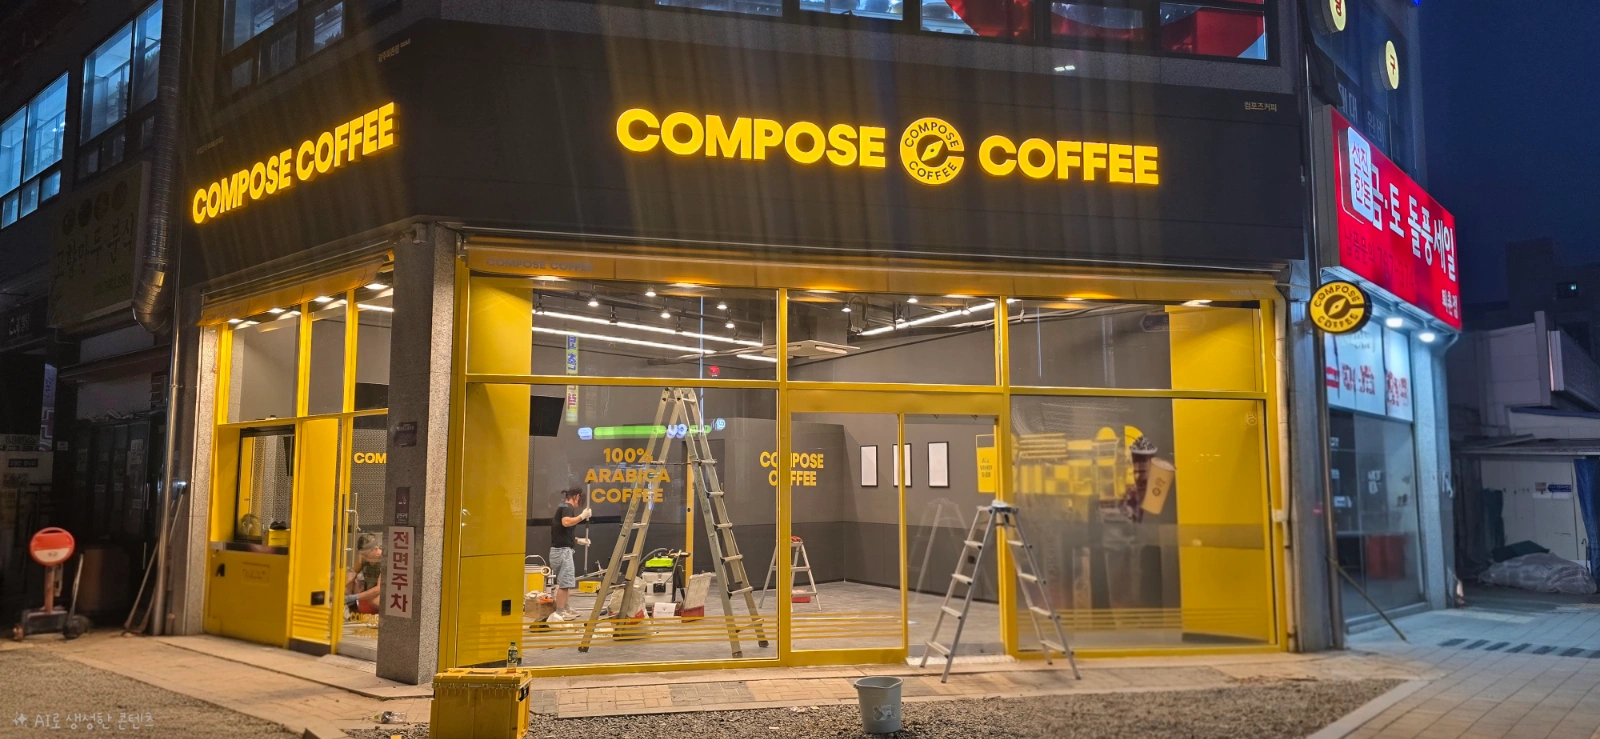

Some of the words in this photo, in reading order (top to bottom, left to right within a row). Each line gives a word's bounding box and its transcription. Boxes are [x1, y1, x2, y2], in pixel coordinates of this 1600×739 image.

[1244, 101, 1278, 112] 컴포즈커피
[904, 121, 960, 148] COMPOSE
[616, 108, 886, 168] COMPOSE
[979, 134, 1159, 185] COFFEE
[192, 148, 293, 224] COMPOSE
[296, 101, 395, 181] COFFEE
[908, 160, 958, 181] COFFEE
[1354, 169, 1371, 211] 한돈
[487, 258, 546, 269] COMPOSE
[1313, 285, 1360, 308] COMPOSE
[1317, 313, 1359, 329] COFFEE
[603, 447, 654, 463] 100%
[759, 451, 824, 469] COPOSE
[584, 468, 671, 483] ARABICA
[768, 470, 817, 486] CFFEE
[591, 488, 664, 503] COFFEE
[389, 531, 409, 613] 전면주차
